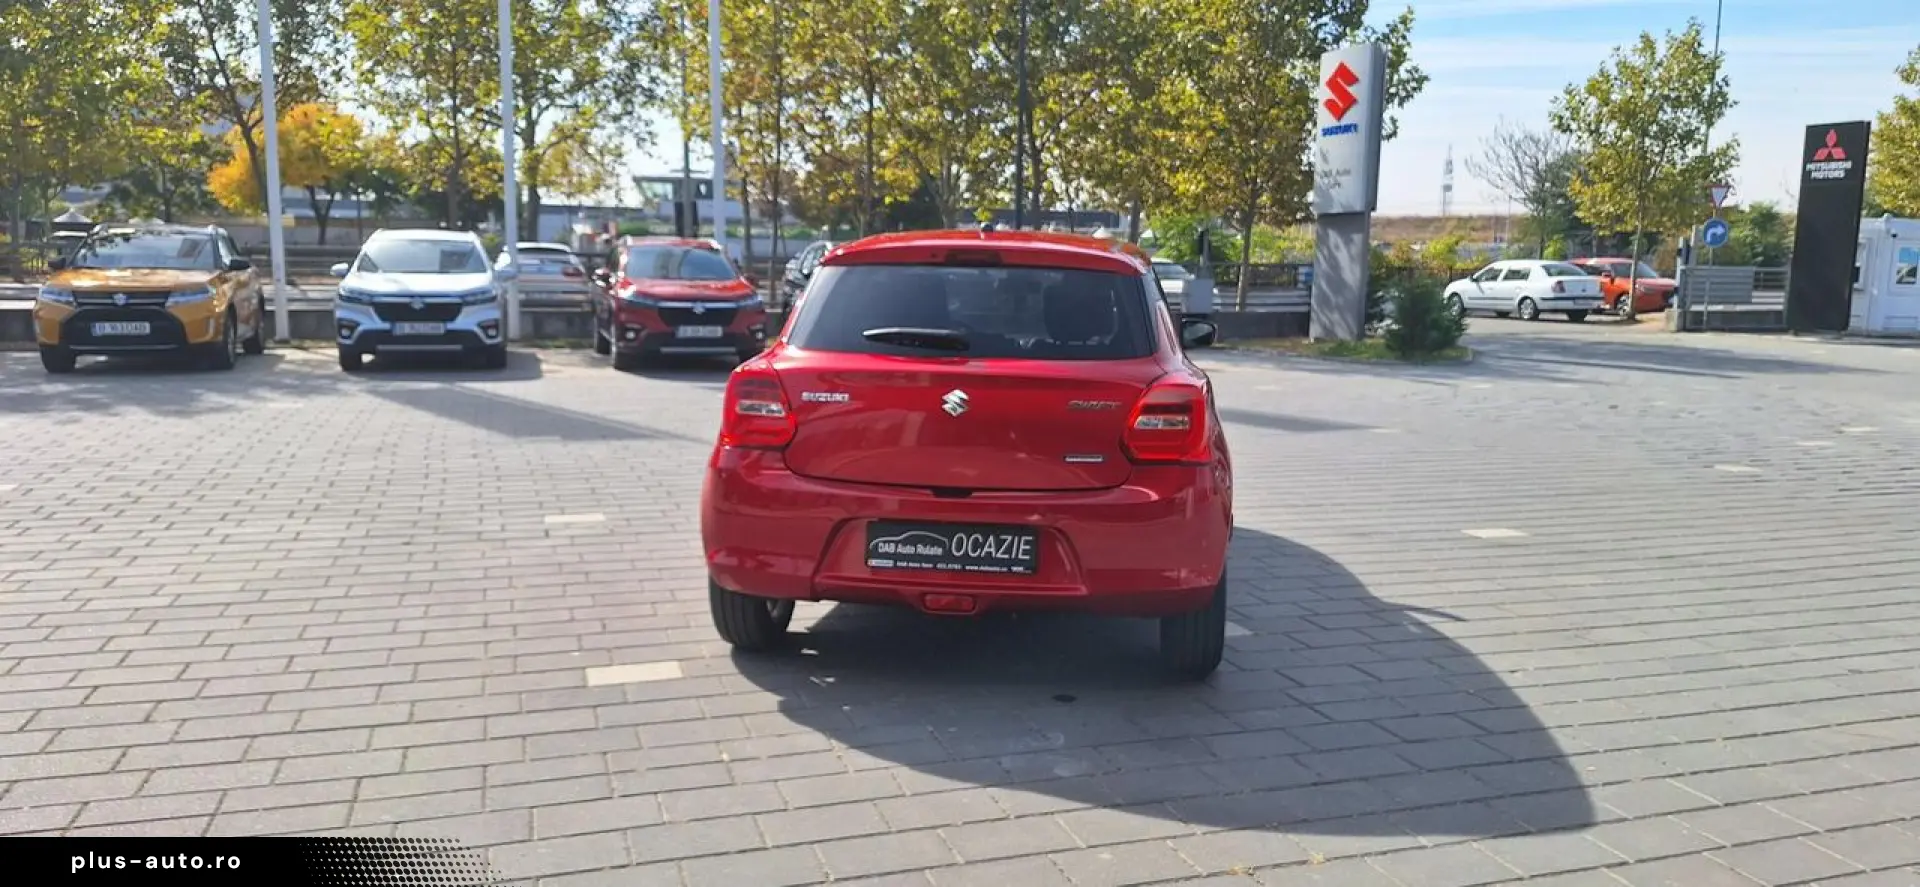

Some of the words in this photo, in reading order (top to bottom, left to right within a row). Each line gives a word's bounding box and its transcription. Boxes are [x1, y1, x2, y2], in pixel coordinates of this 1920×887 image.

[1321, 123, 1358, 136] SUZUKI
[1805, 160, 1852, 171] MITSUBISHI
[1811, 169, 1845, 179] MOTORS
[801, 391, 849, 402] SUZUKI
[878, 542, 895, 553] DAB
[896, 543, 915, 554] Auto
[916, 544, 943, 556] Rulate
[951, 532, 1033, 560] OCAZIE
